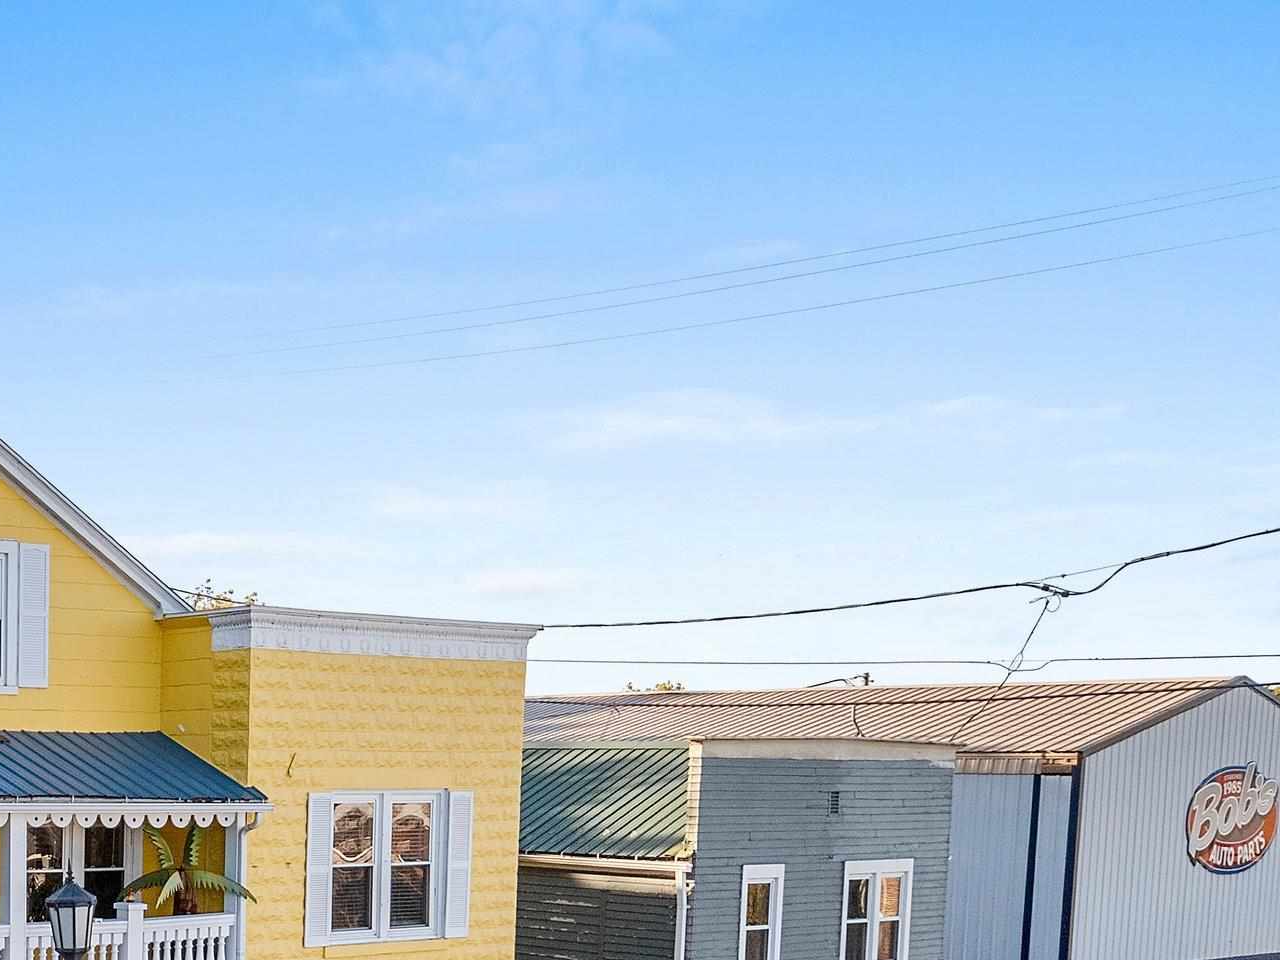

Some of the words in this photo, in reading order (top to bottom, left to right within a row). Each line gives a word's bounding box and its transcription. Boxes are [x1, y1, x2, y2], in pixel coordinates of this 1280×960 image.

[1187, 760, 1278, 860] Bob's
[1208, 843, 1235, 866] AUTO
[1237, 831, 1266, 865] PARTS
